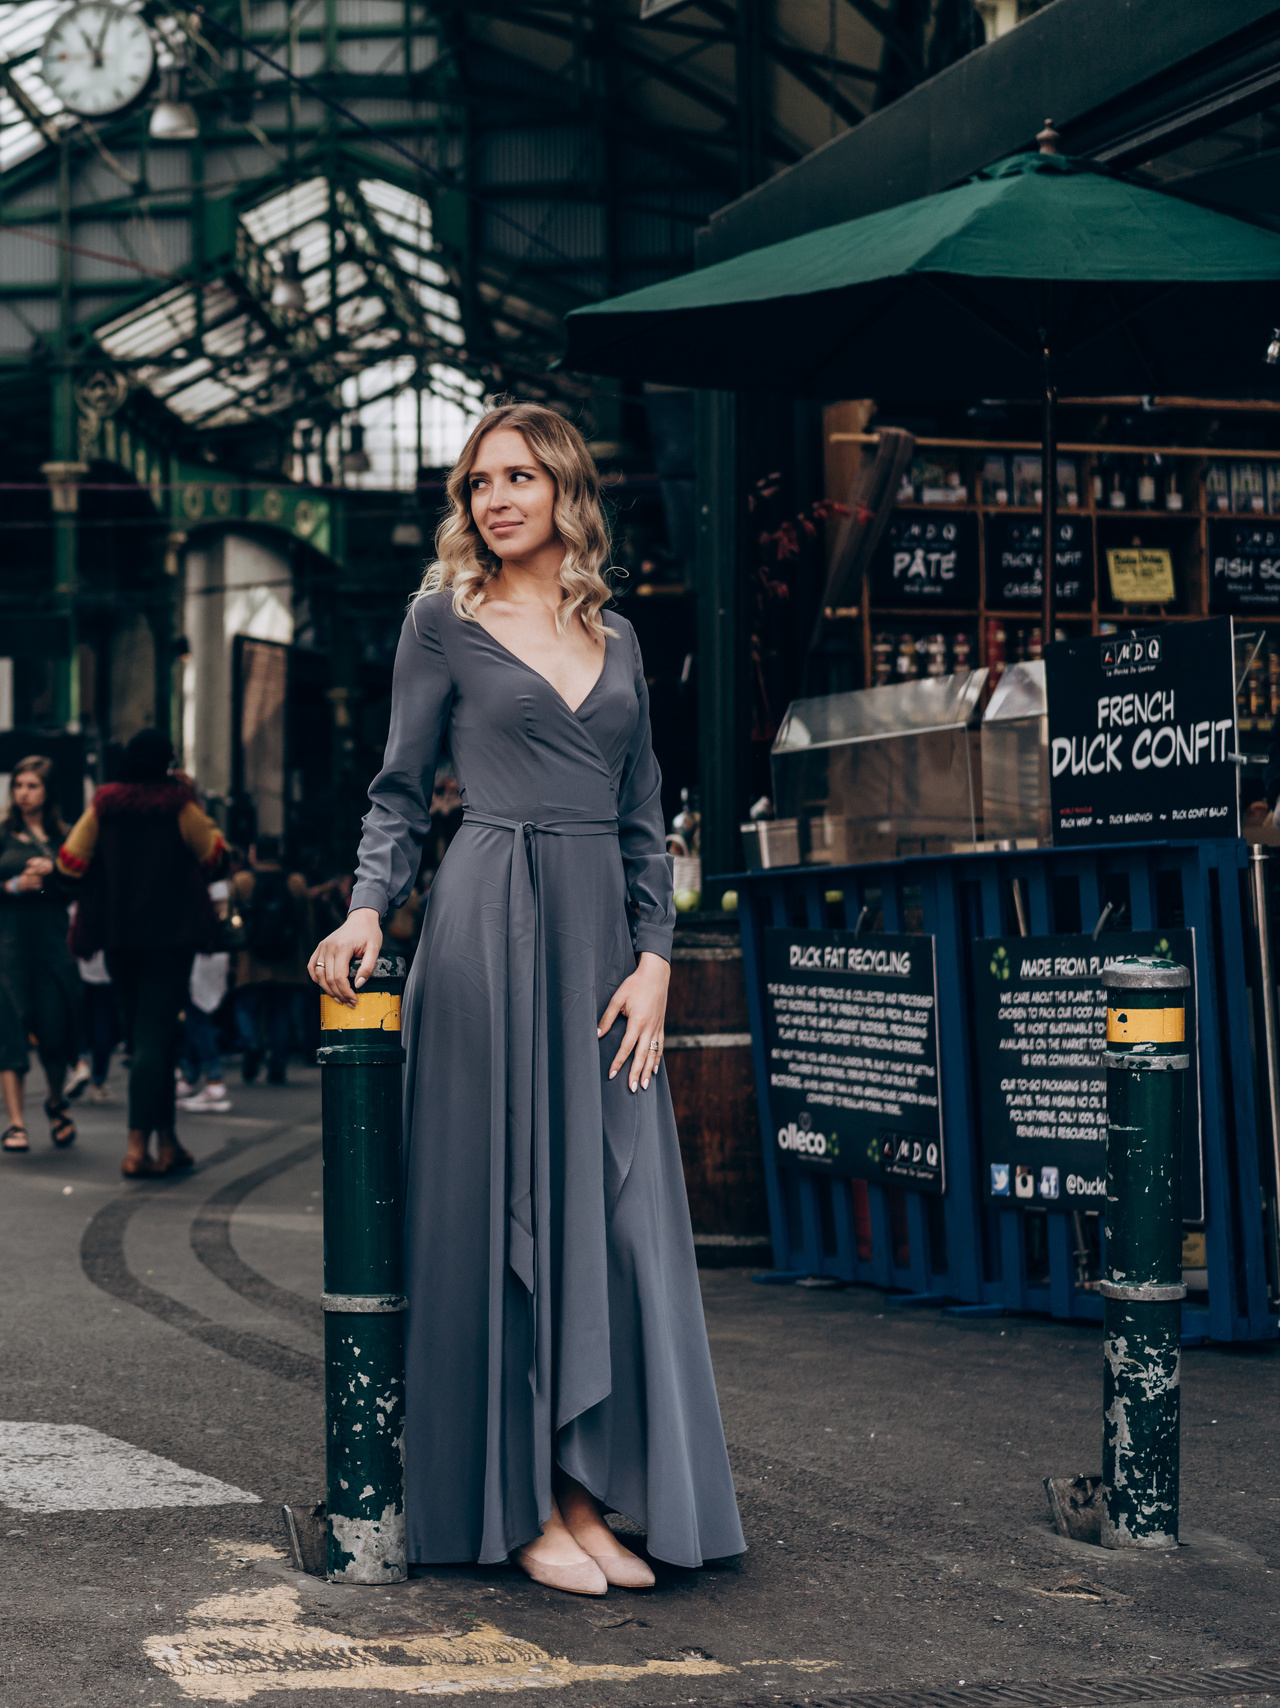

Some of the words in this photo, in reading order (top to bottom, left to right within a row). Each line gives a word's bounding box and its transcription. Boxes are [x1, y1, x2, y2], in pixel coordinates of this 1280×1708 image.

[1037, 551, 1082, 567] CNFIT
[1215, 557, 1254, 578] FISH
[1260, 558, 1280, 579] SO
[1098, 689, 1174, 729] FRENCH
[1052, 732, 1123, 778] DUCK
[1132, 718, 1232, 770] CONFIT
[1060, 818, 1075, 828] DUCK
[1109, 814, 1124, 825] DUCK
[1172, 810, 1187, 820] DUCK
[790, 944, 822, 968] DUCK
[824, 946, 847, 968] FAT
[848, 948, 912, 974] RECYCLING
[1020, 958, 1052, 978] MADE
[1054, 956, 1088, 976] FROM
[1000, 991, 1012, 1004] WE
[1013, 991, 1030, 1004] CARE
[1031, 990, 1054, 1004] ABOUT
[1054, 990, 1066, 1004] THE
[1096, 990, 1107, 1003] THA
[998, 1007, 1027, 1020] CHOSEN
[1028, 1006, 1037, 1019] TO
[1038, 1006, 1056, 1019] PACK
[1057, 1006, 1072, 1019] OUR
[1072, 1006, 1093, 1019] FOOD
[1094, 1006, 1107, 1019] AND
[1013, 1022, 1026, 1035] THE
[1027, 1022, 1048, 1035] MOST
[1049, 1022, 1093, 1035] SUSTAINABLE
[1094, 1022, 1107, 1035] TO-
[999, 1038, 1034, 1050] AVAILABLE
[1035, 1038, 1047, 1050] ON
[1048, 1038, 1060, 1050] THE
[1061, 1038, 1088, 1050] MARKET
[1088, 1038, 1107, 1050] TODA
[1021, 1054, 1029, 1066] IS
[1030, 1054, 1047, 1066] 100%
[1000, 1078, 1016, 1091] OUR
[1017, 1079, 1041, 1092] TO-GO
[1042, 1079, 1079, 1092] PACKAGING
[1080, 1079, 1088, 1092] IS
[1006, 1094, 1033, 1106] PLANTS.
[1035, 1094, 1050, 1107] THIS
[1051, 1095, 1076, 1108] MEANS
[1076, 1095, 1088, 1108] NO
[1089, 1095, 1101, 1108] OIL
[1058, 1110, 1077, 1124] ONLY
[1078, 1111, 1095, 1124] 100%
[778, 1122, 826, 1156] olleco
[1016, 1125, 1056, 1139] RENEWABLE
[1057, 1127, 1098, 1140] RESOURCES
[1066, 1174, 1107, 1196] @Duck
